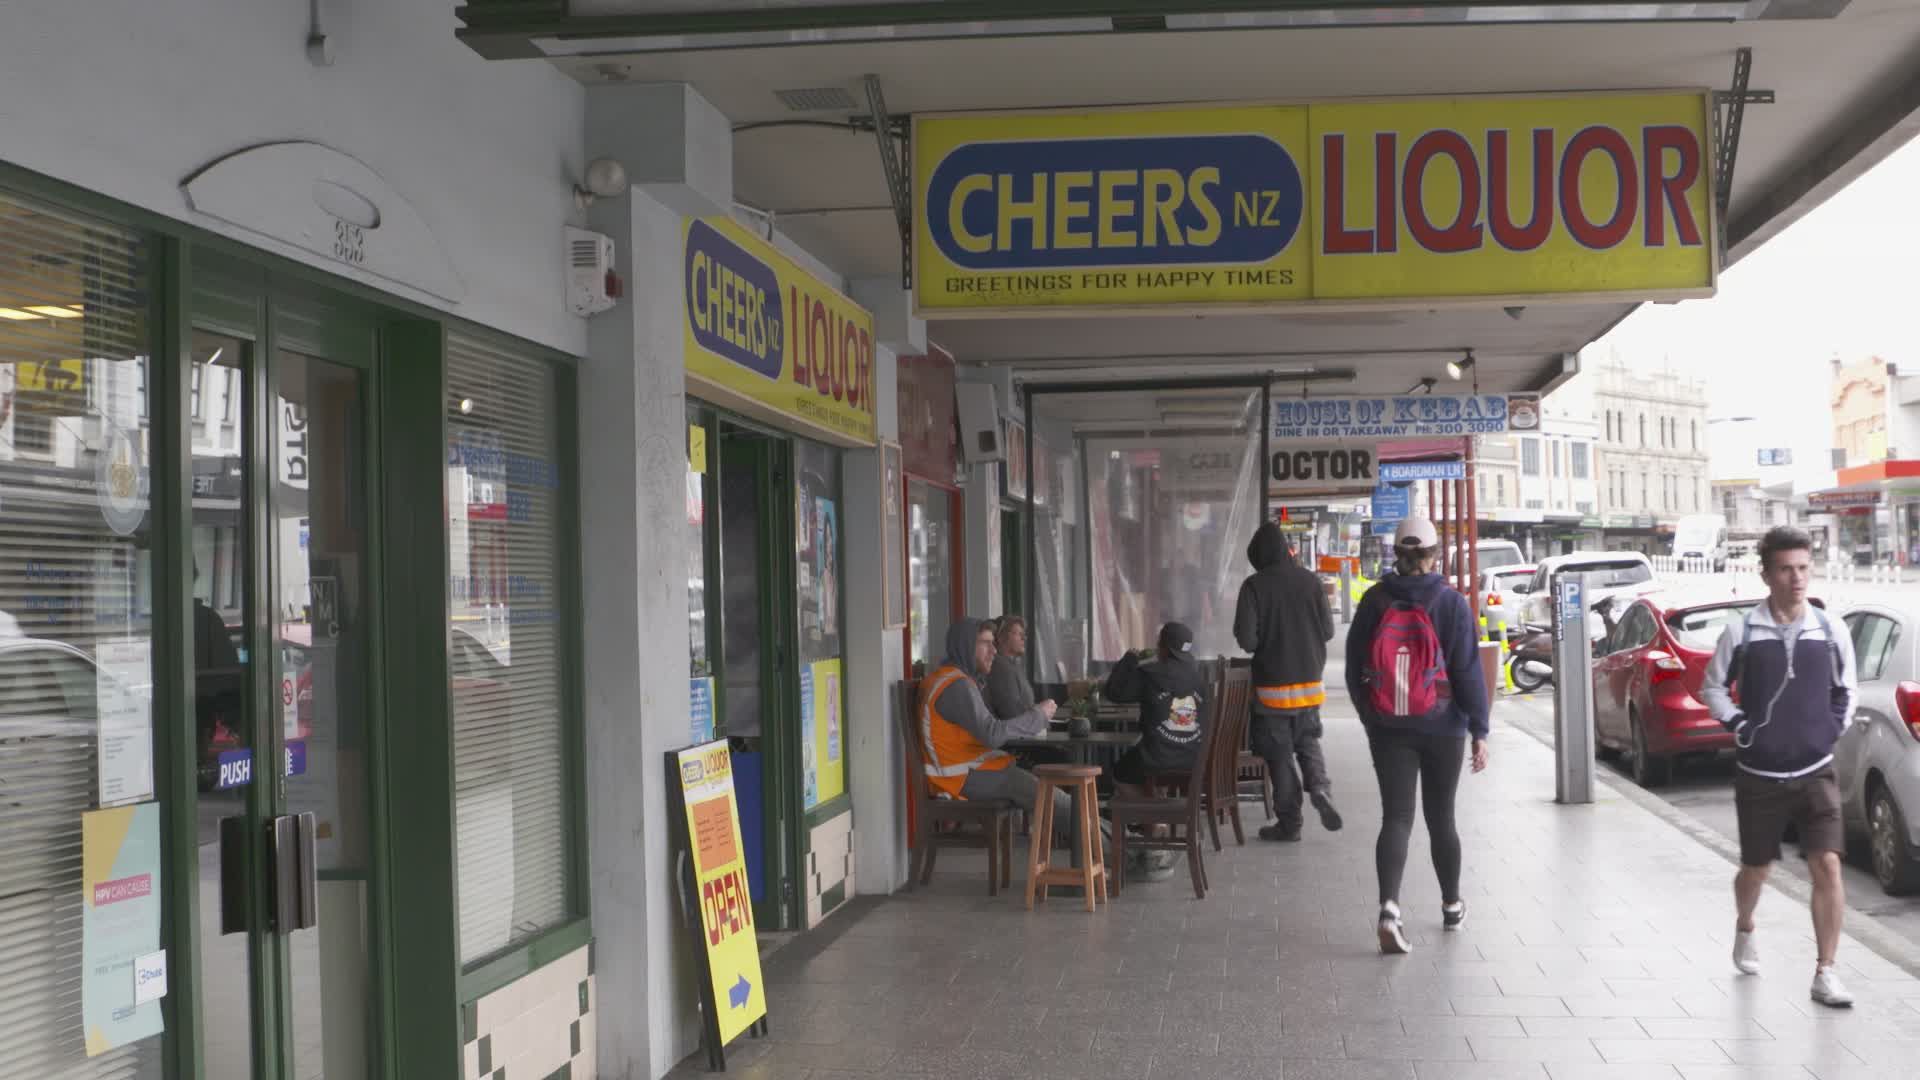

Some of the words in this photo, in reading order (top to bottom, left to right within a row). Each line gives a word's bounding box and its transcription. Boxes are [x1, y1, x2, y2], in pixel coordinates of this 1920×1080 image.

[1322, 124, 1703, 254] LIQUOR
[949, 166, 1222, 252] CHEERS
[1233, 190, 1281, 227] NZ
[945, 273, 1072, 294] GREETINGS
[1082, 272, 1127, 289] FOR
[1137, 271, 1215, 289] HAPPY
[1216, 268, 1294, 287] TIMES
[692, 251, 767, 360] CHEERS
[791, 285, 872, 414] LIQUOR
[1275, 400, 1351, 426] HOUSE
[1391, 396, 1506, 423] KEBAB
[1275, 427, 1302, 437] DINE
[1307, 427, 1319, 437] IN
[1323, 427, 1339, 436] OR
[1343, 425, 1407, 436] TAKEAWAY
[1435, 423, 1463, 434] 300
[1467, 421, 1504, 433] 3090
[1268, 450, 1372, 481] OCTOR
[1391, 464, 1445, 478] BOARDMAN
[1447, 464, 1461, 476] LN
[220, 758, 250, 787] PUSH
[95, 888, 111, 900] HPV
[111, 885, 127, 898] CAN
[703, 867, 750, 946] OPEN
